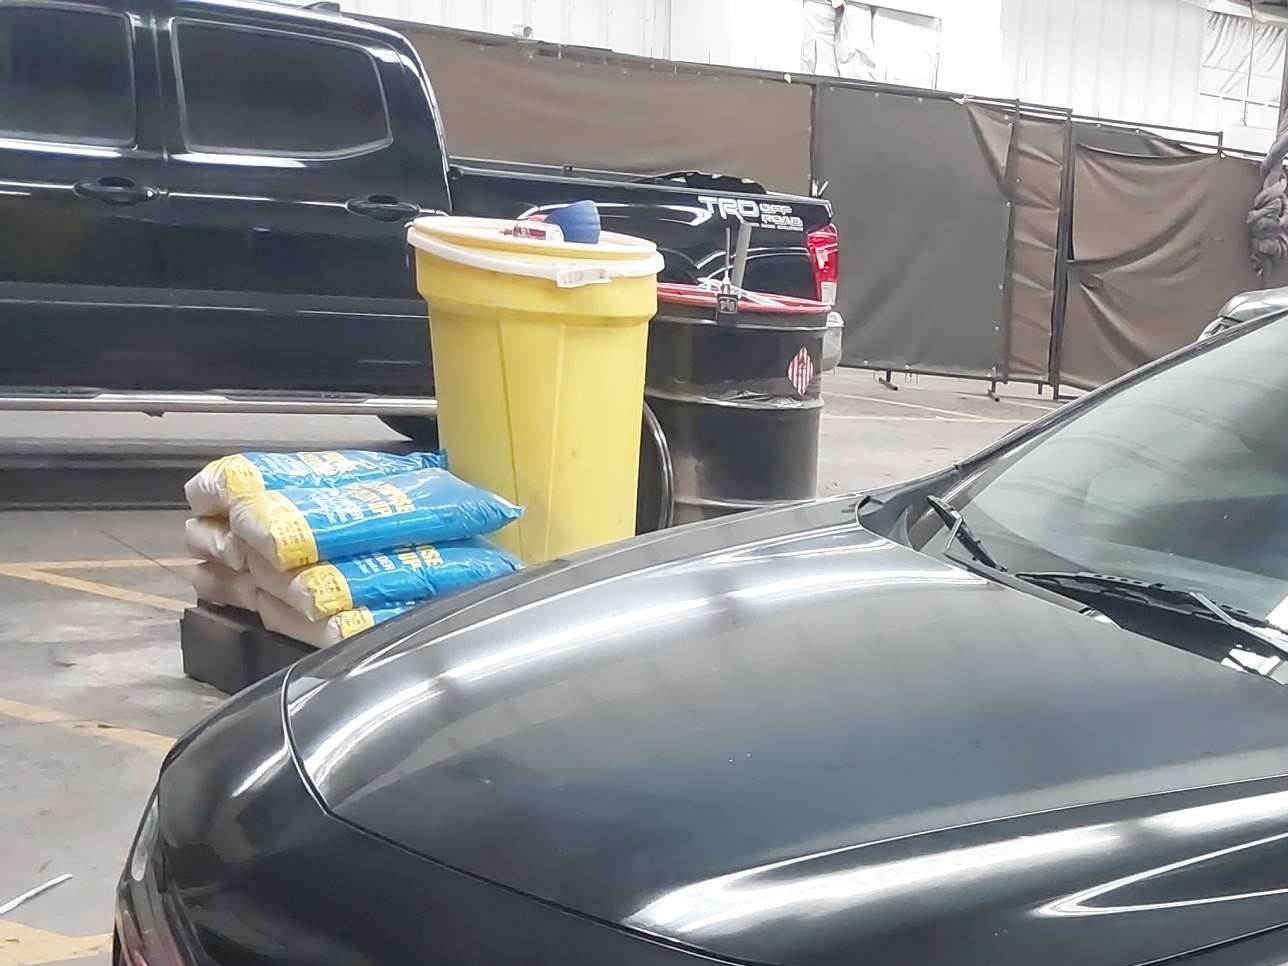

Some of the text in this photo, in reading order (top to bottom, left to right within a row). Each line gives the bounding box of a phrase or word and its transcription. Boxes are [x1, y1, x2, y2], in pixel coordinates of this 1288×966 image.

[698, 195, 760, 224] TRD
[759, 203, 792, 214] OFF
[760, 213, 804, 226] ROAD
